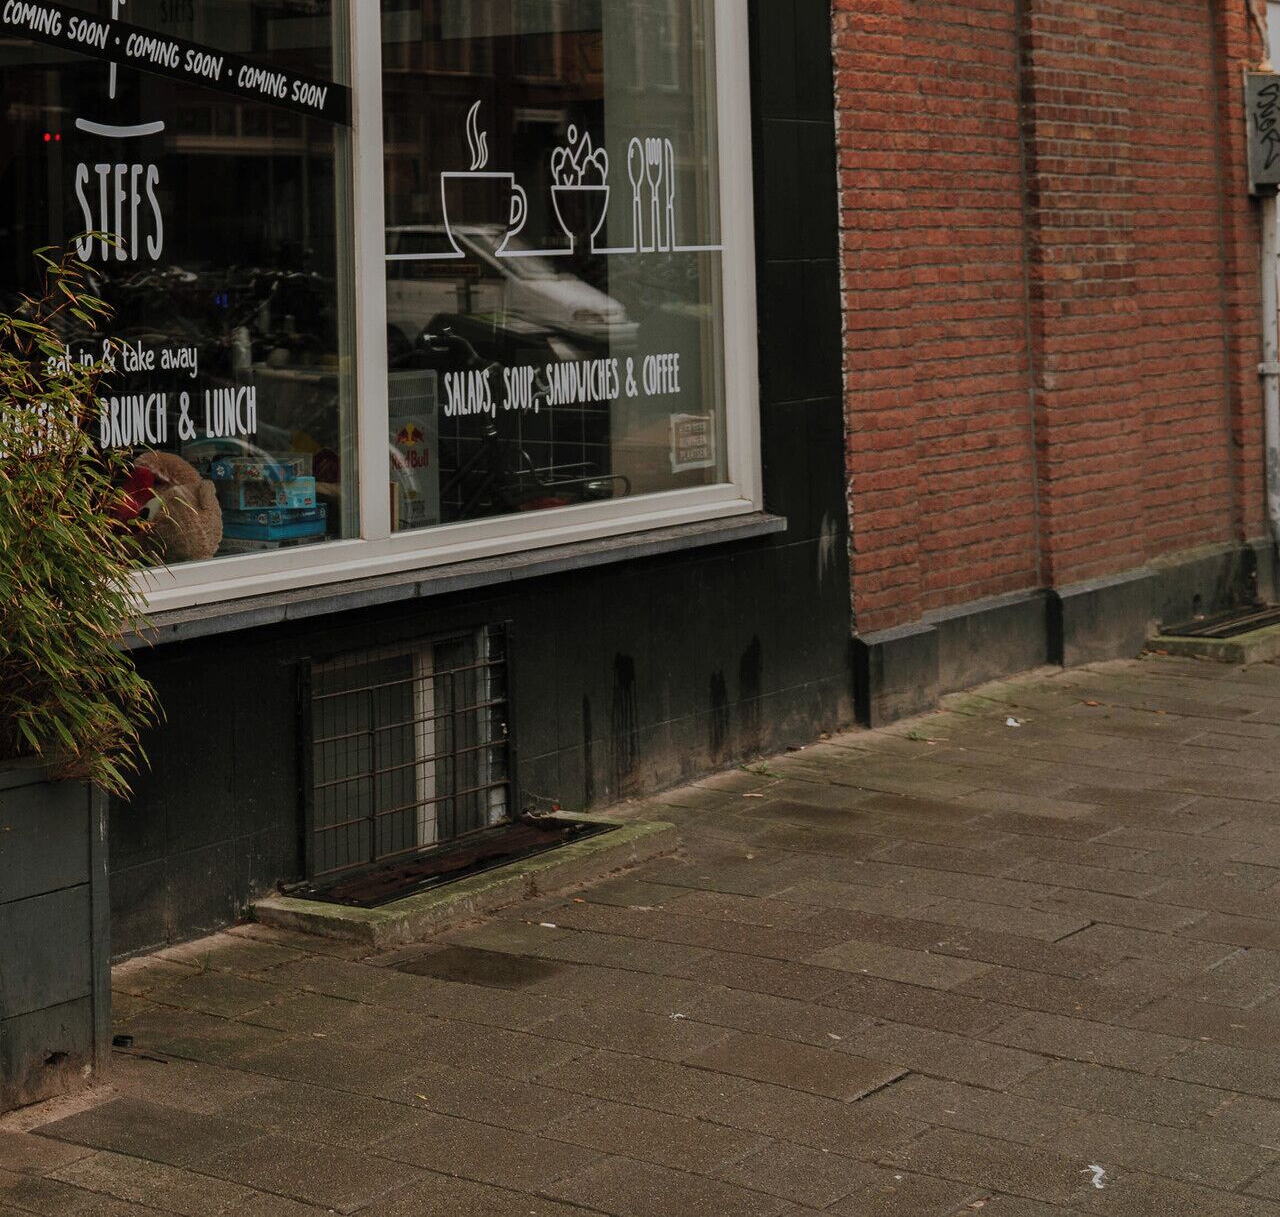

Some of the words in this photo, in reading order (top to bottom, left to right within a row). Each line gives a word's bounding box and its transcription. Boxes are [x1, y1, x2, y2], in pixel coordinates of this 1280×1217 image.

[3, 0, 62, 36] COMING
[68, 17, 110, 49] SOON
[126, 34, 180, 69] COMING
[185, 50, 223, 81] SOON
[237, 66, 288, 99] COMING
[292, 81, 328, 110] SOON
[76, 162, 164, 262] STEFS
[47, 344, 73, 376] eat
[79, 348, 94, 376] in
[102, 338, 116, 373] &
[122, 340, 155, 372] take
[161, 347, 198, 379] away
[444, 367, 496, 419] SALADS,
[503, 365, 540, 414] SOUP,
[544, 358, 620, 406] SANDWICHES
[625, 356, 639, 398] &
[642, 352, 682, 397] COFFEE
[100, 392, 168, 450] BRUNCH
[178, 391, 197, 441] &
[205, 385, 257, 438] LUNCH
